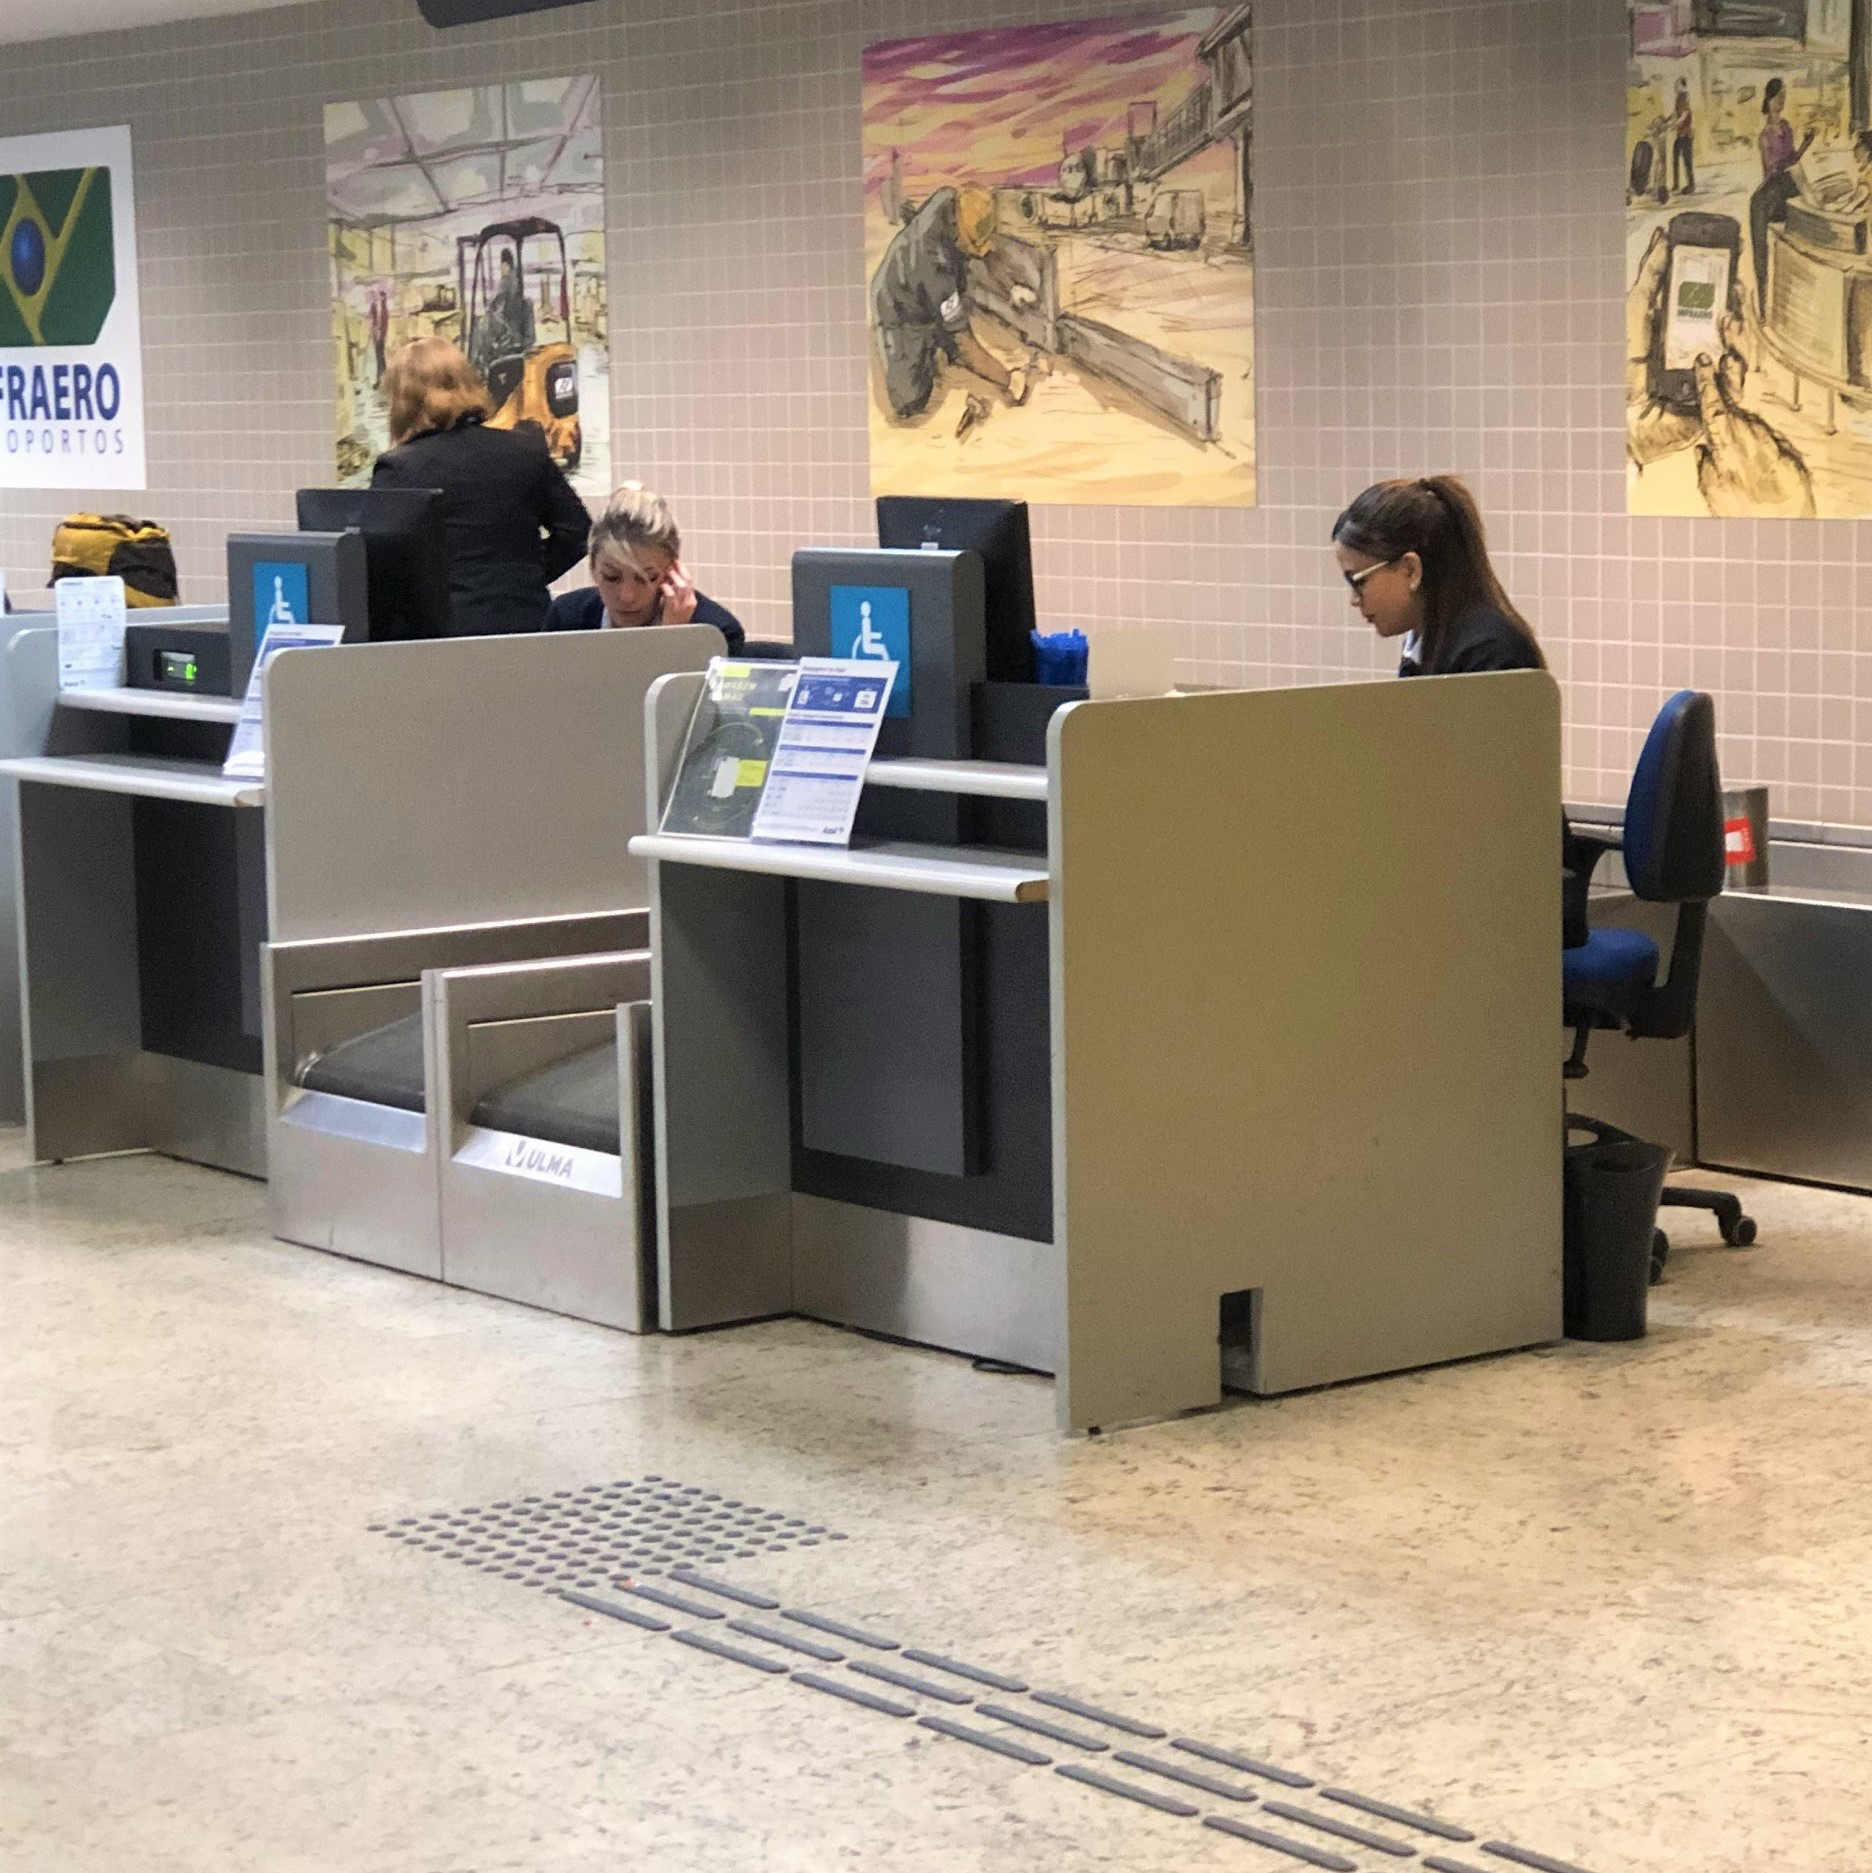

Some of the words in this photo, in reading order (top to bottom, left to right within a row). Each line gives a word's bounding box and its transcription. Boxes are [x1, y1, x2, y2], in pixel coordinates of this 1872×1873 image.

[0, 363, 120, 420] RAERO
[7, 429, 123, 454] OPORTOS
[527, 1150, 573, 1177] ULMA
